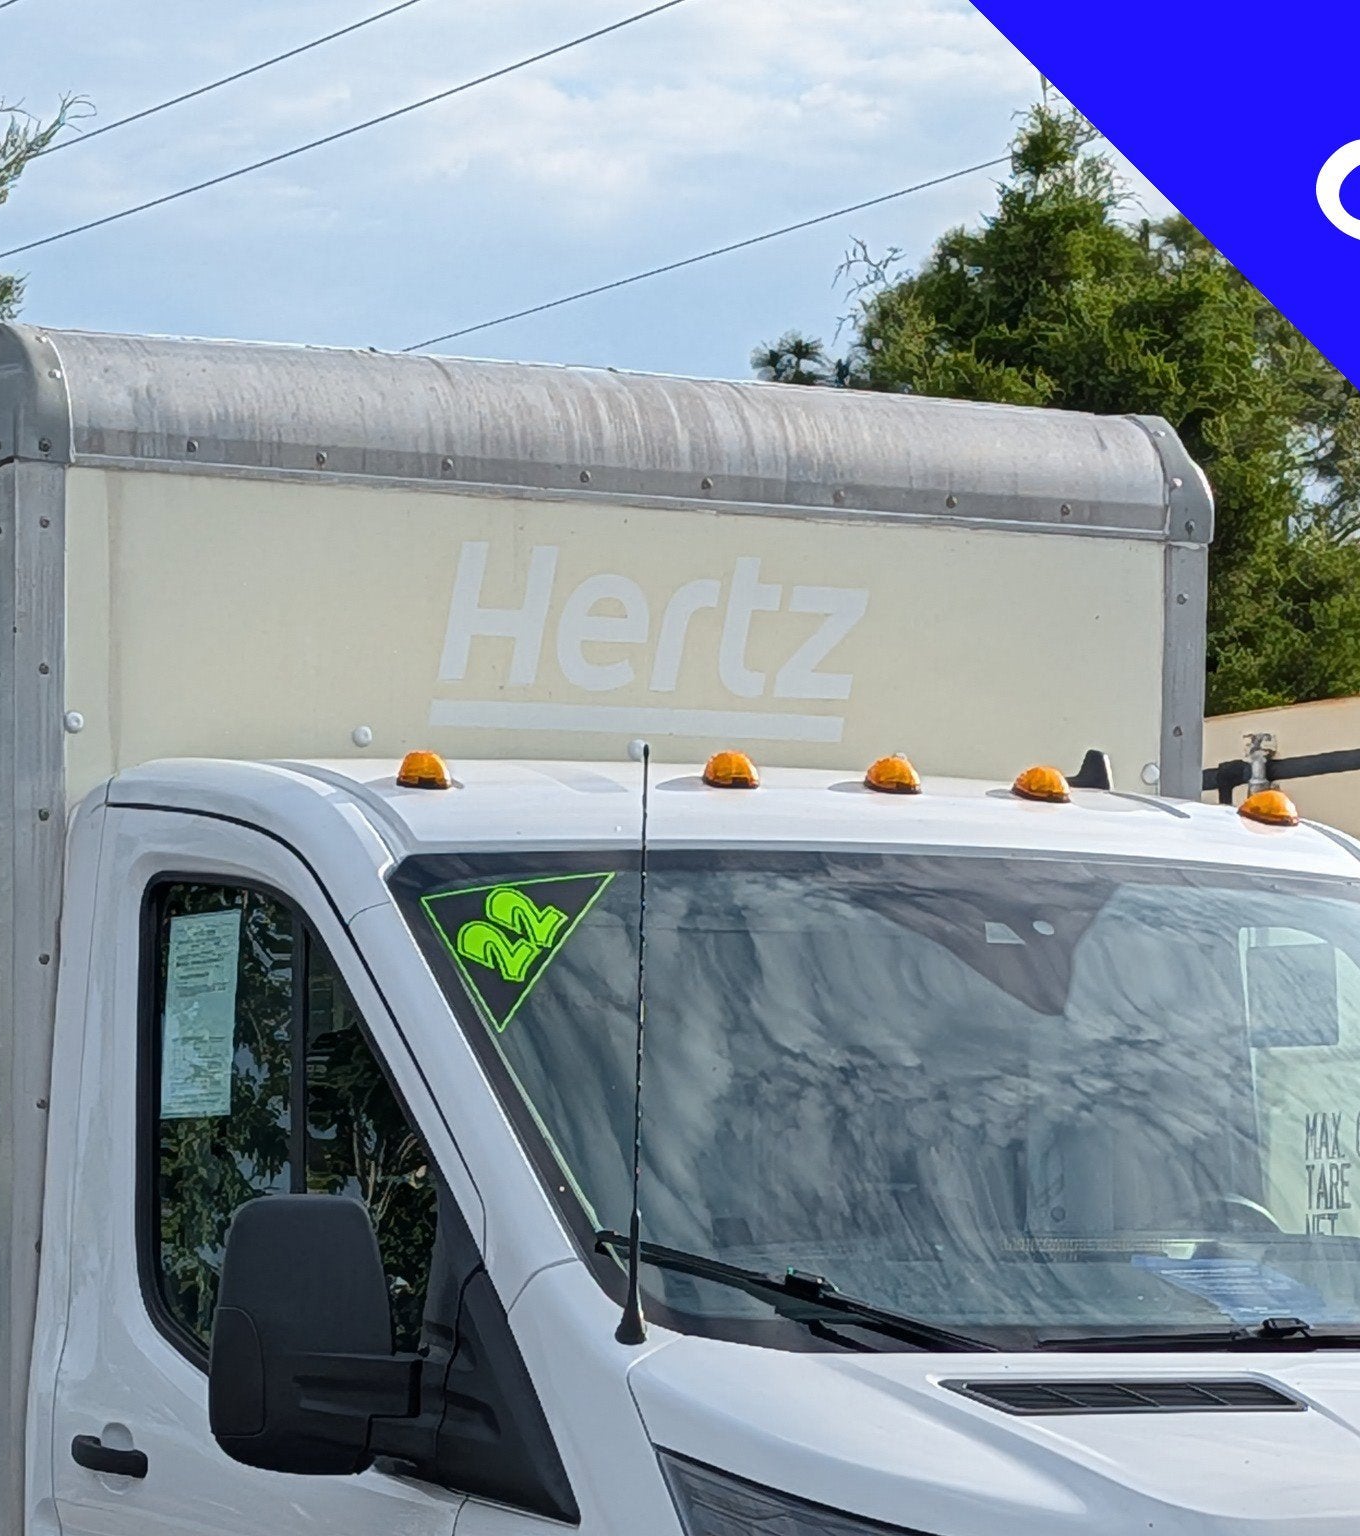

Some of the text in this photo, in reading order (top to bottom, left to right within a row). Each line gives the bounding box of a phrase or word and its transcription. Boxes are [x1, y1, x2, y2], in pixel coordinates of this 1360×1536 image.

[439, 541, 871, 699] Hertz
[457, 887, 569, 982] 22
[1305, 1162, 1352, 1210] TARE
